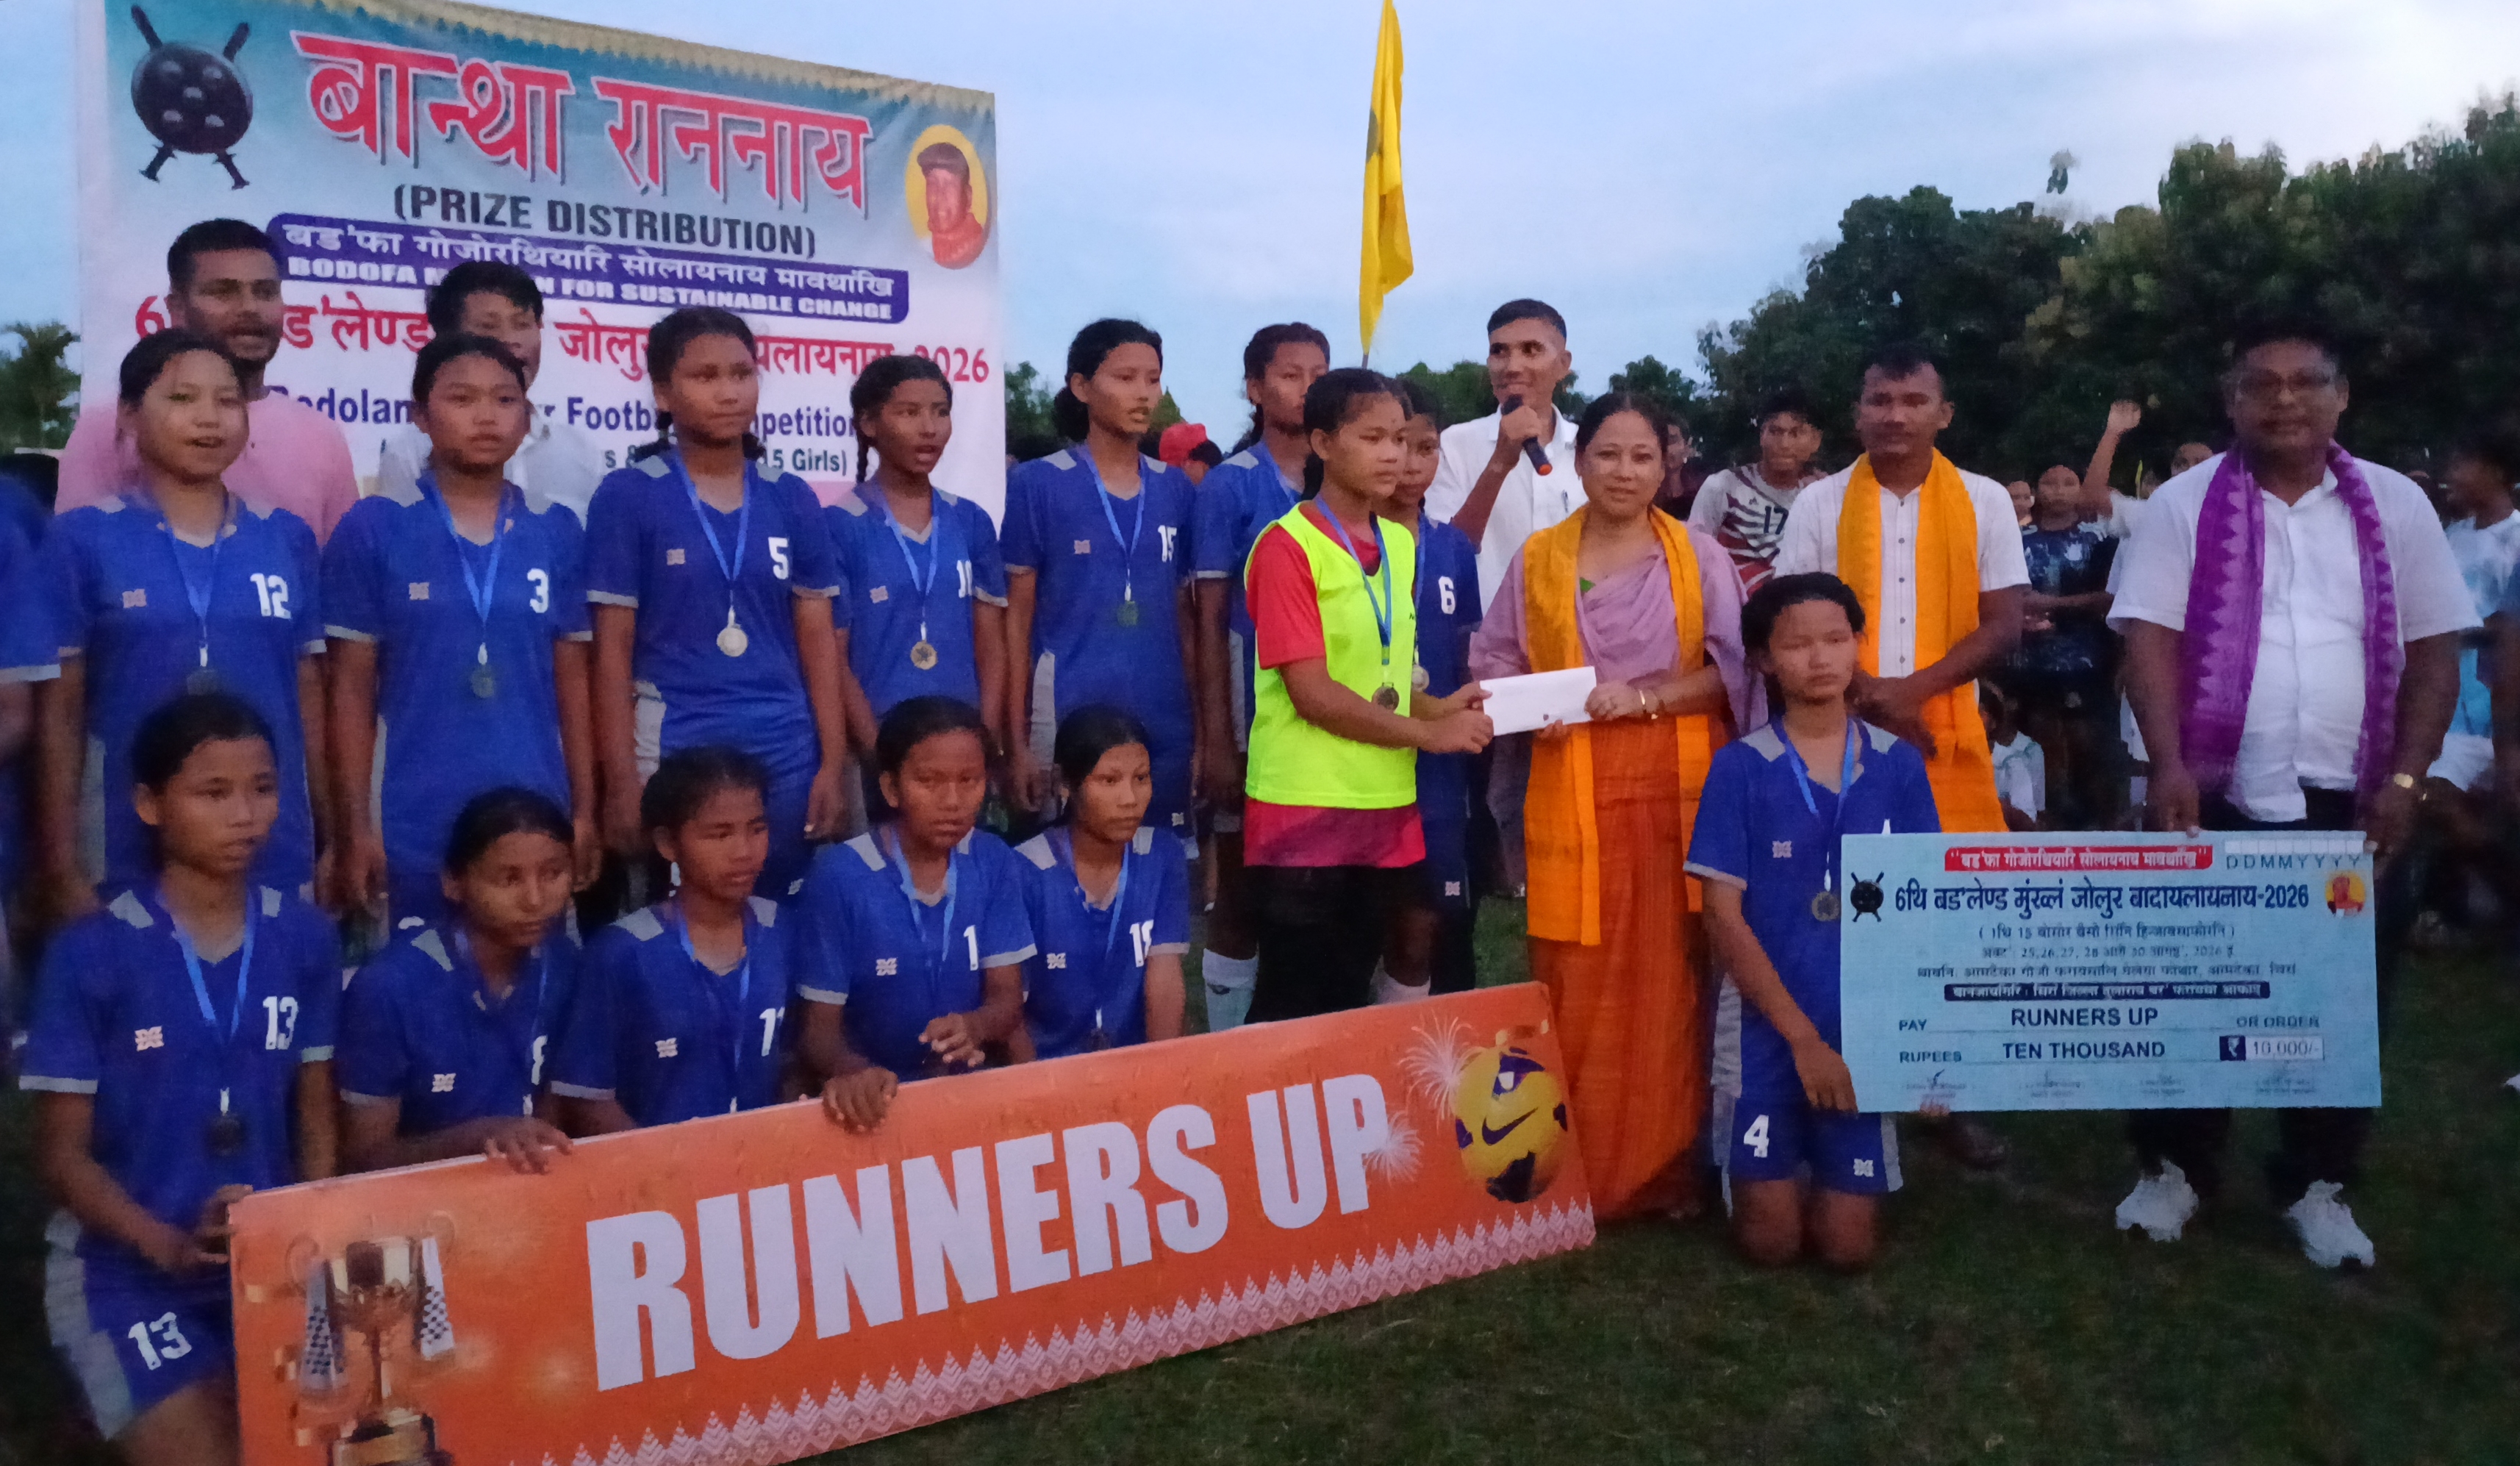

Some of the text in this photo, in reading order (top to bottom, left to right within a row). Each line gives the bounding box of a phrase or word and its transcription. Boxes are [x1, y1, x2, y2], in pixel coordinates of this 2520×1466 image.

[394, 184, 816, 260] (PRIZE DISTRIBUTION)
[562, 277, 615, 301] FOR
[620, 282, 793, 313] SUSTAINABLE
[798, 296, 892, 321] CHANGE
[554, 307, 651, 382] जोलु
[792, 448, 847, 476] Girls)
[1764, 505, 1789, 535] 17
[767, 537, 790, 580] 5
[250, 573, 293, 620] 12
[527, 568, 550, 613] 3
[1438, 576, 1456, 615] 6
[2070, 875, 2124, 920] जोलुर
[963, 924, 978, 971] 1
[262, 995, 298, 1050] 13
[1899, 1019, 1927, 1031] PAY
[2011, 1007, 2158, 1027] RUNNERS UP
[2002, 1043, 2042, 1059] TEN
[2049, 1041, 2166, 1059] THOUSAND
[1743, 1115, 1770, 1158] 4
[586, 1073, 1389, 1392] RUNNERS UP
[128, 1312, 192, 1370] 13
